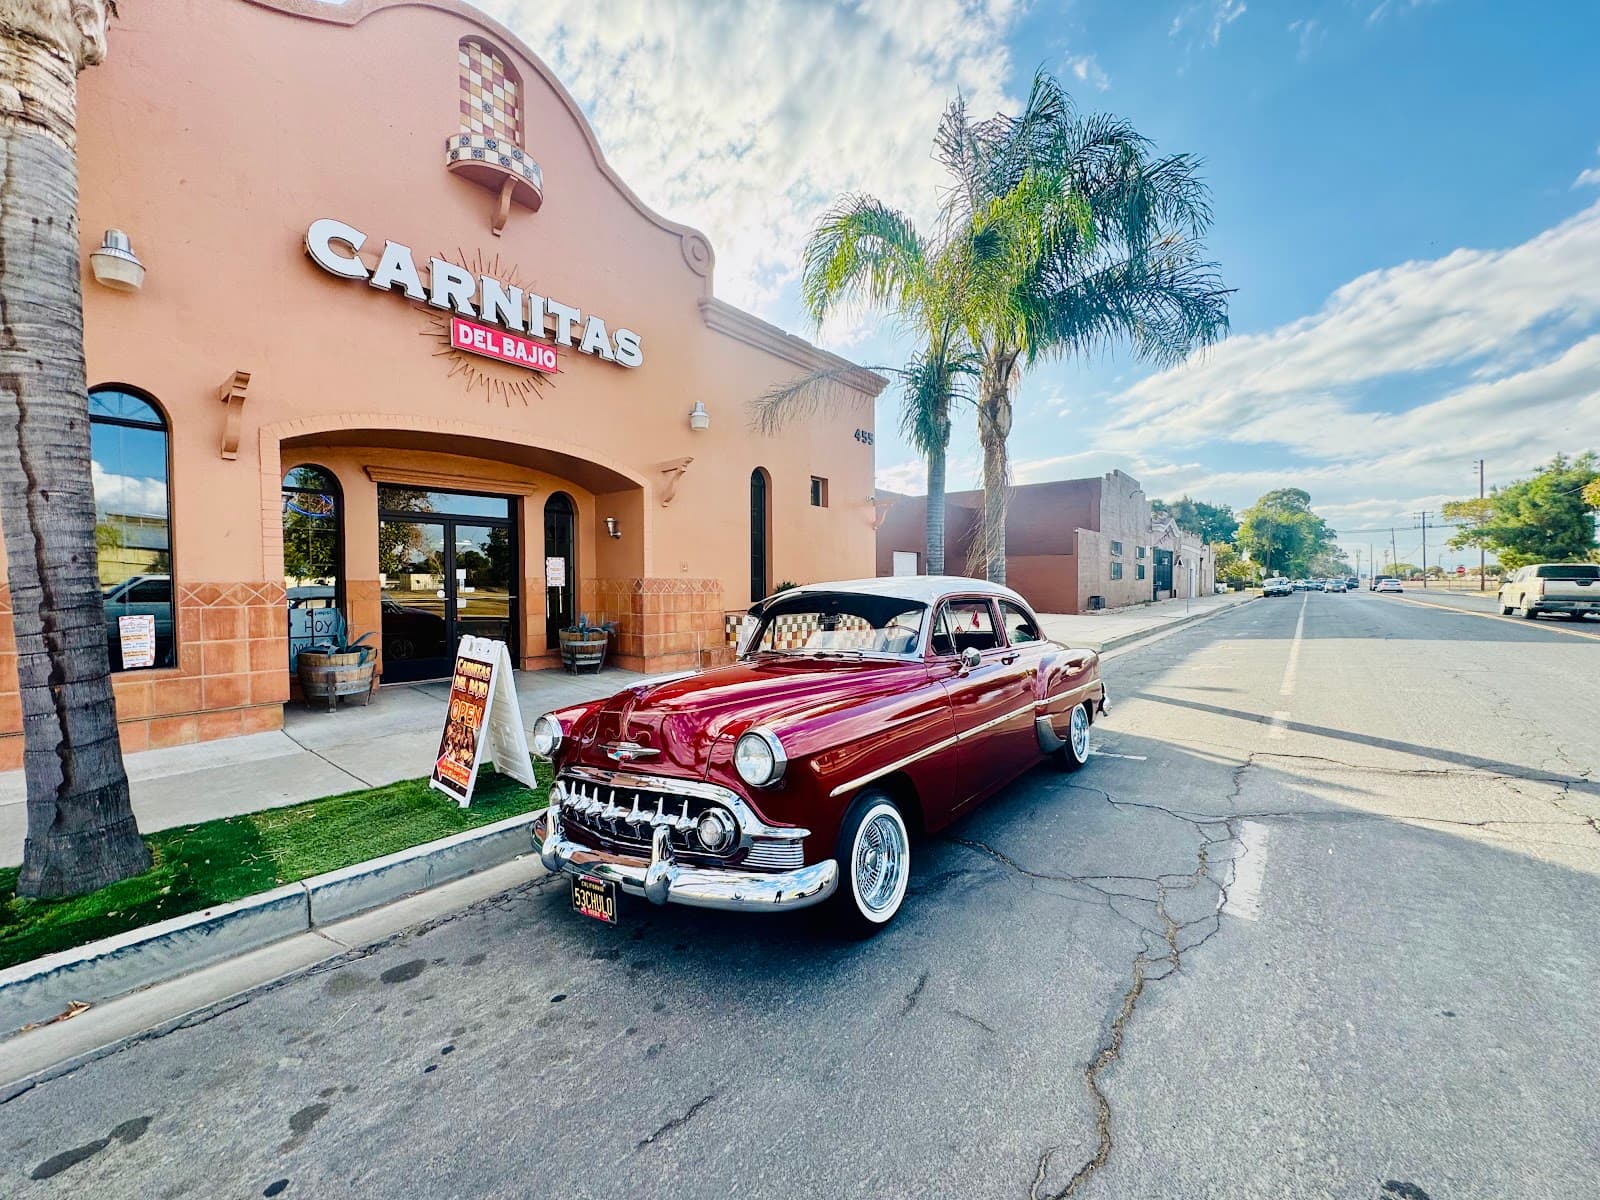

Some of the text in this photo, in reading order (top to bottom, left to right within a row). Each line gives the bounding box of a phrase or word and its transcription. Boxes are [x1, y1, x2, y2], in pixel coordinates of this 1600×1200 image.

[305, 217, 644, 369] CARNITAS
[459, 323, 556, 368] DEL BAJIO
[854, 428, 874, 446] 455
[304, 620, 333, 633] HOY
[458, 659, 491, 681] CARNITAS
[451, 699, 482, 729] OPEN
[575, 888, 612, 916] 53CHULO
